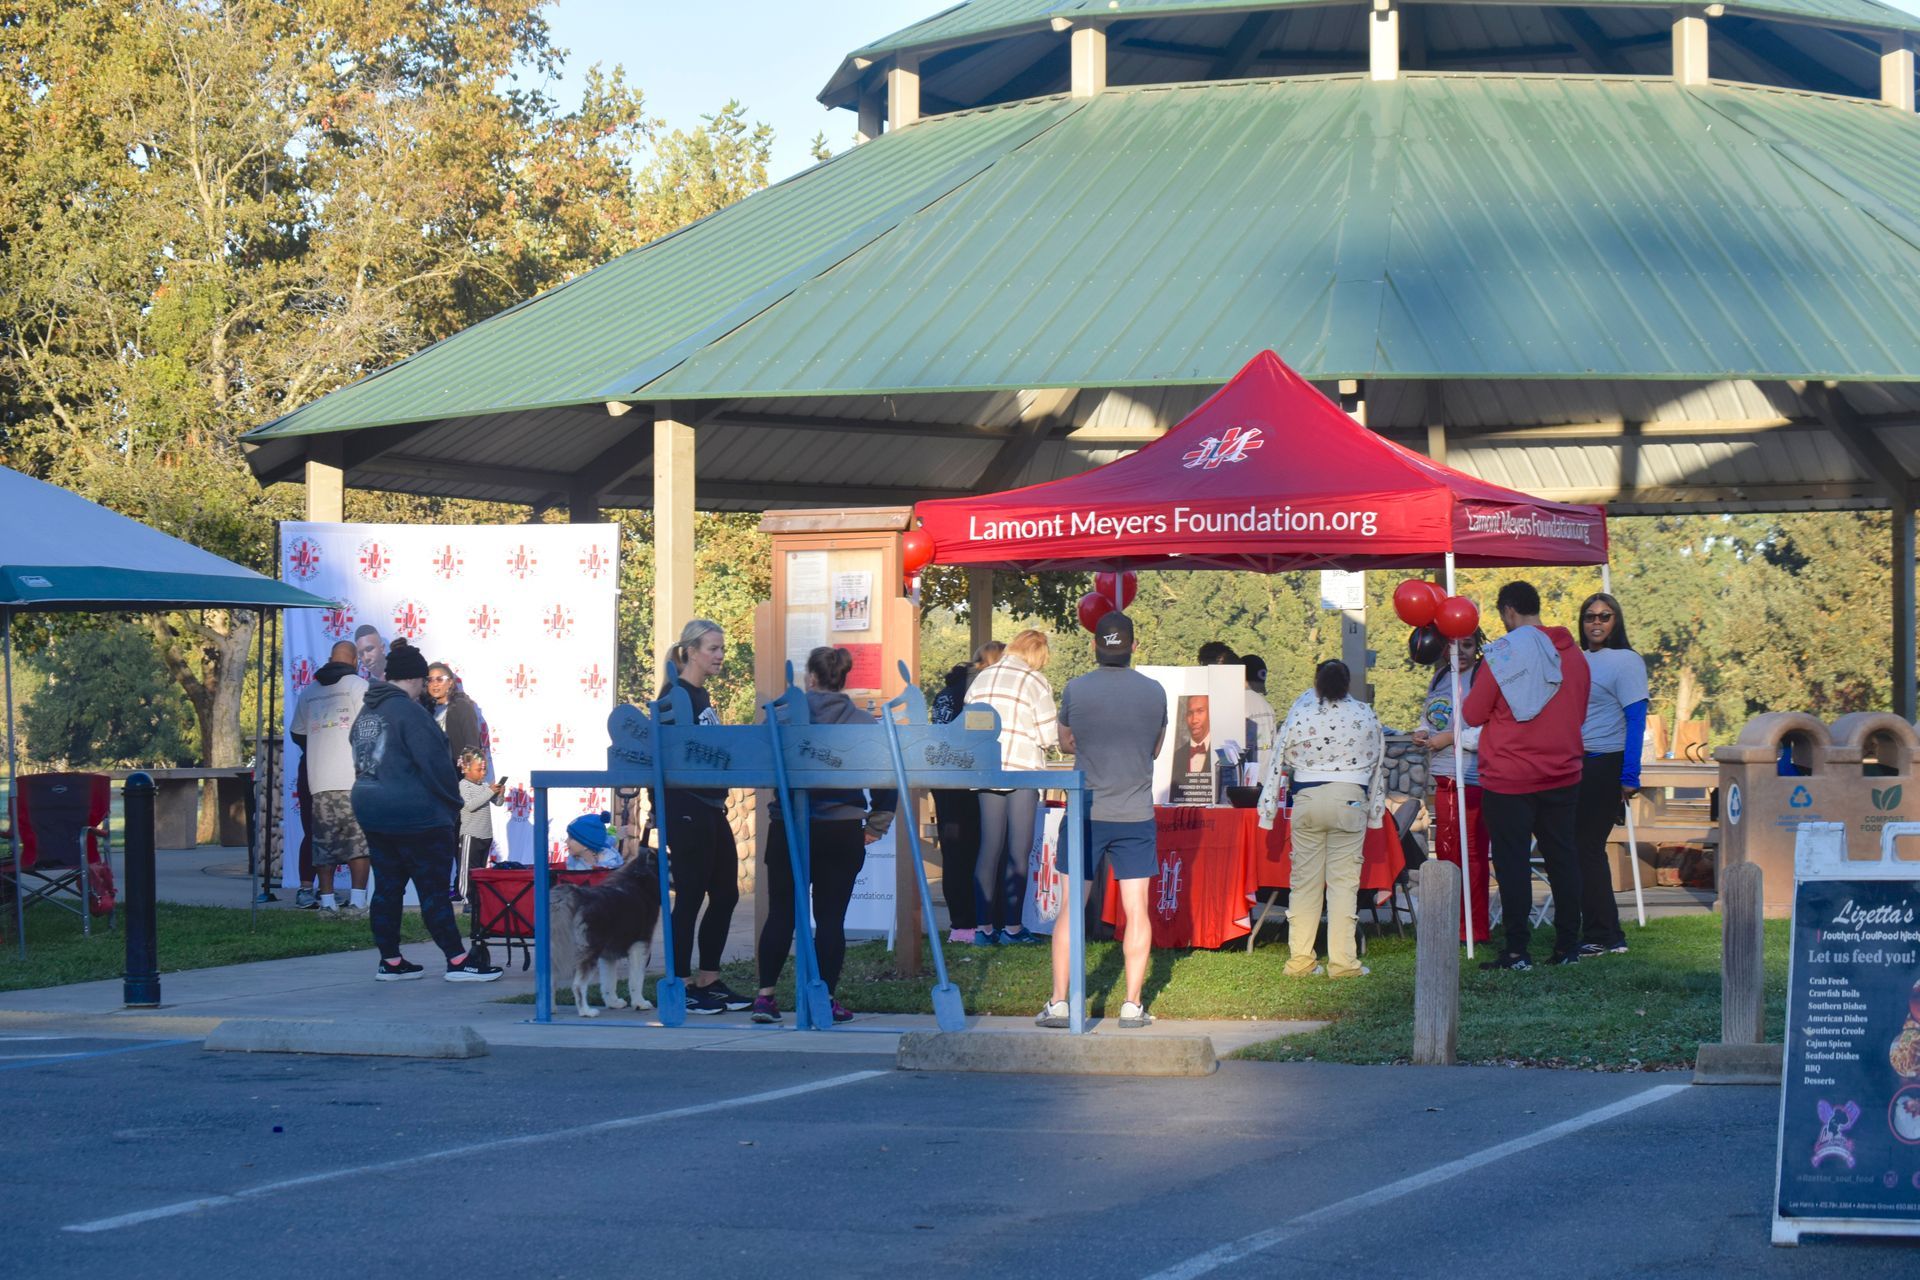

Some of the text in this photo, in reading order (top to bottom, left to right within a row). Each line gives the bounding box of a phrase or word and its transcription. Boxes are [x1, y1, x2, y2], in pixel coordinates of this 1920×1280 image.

[970, 505, 1378, 541] Lamont Meyers Foundation.org
[1465, 507, 1591, 545] Lamont Meyers Foundation.org
[1864, 815, 1904, 823] COMPOST
[851, 891, 894, 900] oundation.or
[1832, 899, 1914, 931] Lizetta's
[1823, 930, 1860, 943] Southern
[1808, 949, 1916, 967] Let us feed you!
[1809, 976, 1849, 986] Crab Feeds
[1808, 989, 1860, 998] Crawfish Boils
[1808, 1002, 1867, 1011] Southern Dishes
[1808, 1014, 1869, 1023] American Dishes
[1807, 1026, 1865, 1035] Southern Creole
[1806, 1039, 1852, 1049] Cajun Spices
[1805, 1051, 1860, 1060] Seafood Dishes
[1804, 1064, 1821, 1074] BBQ
[1804, 1076, 1836, 1085] Desserts
